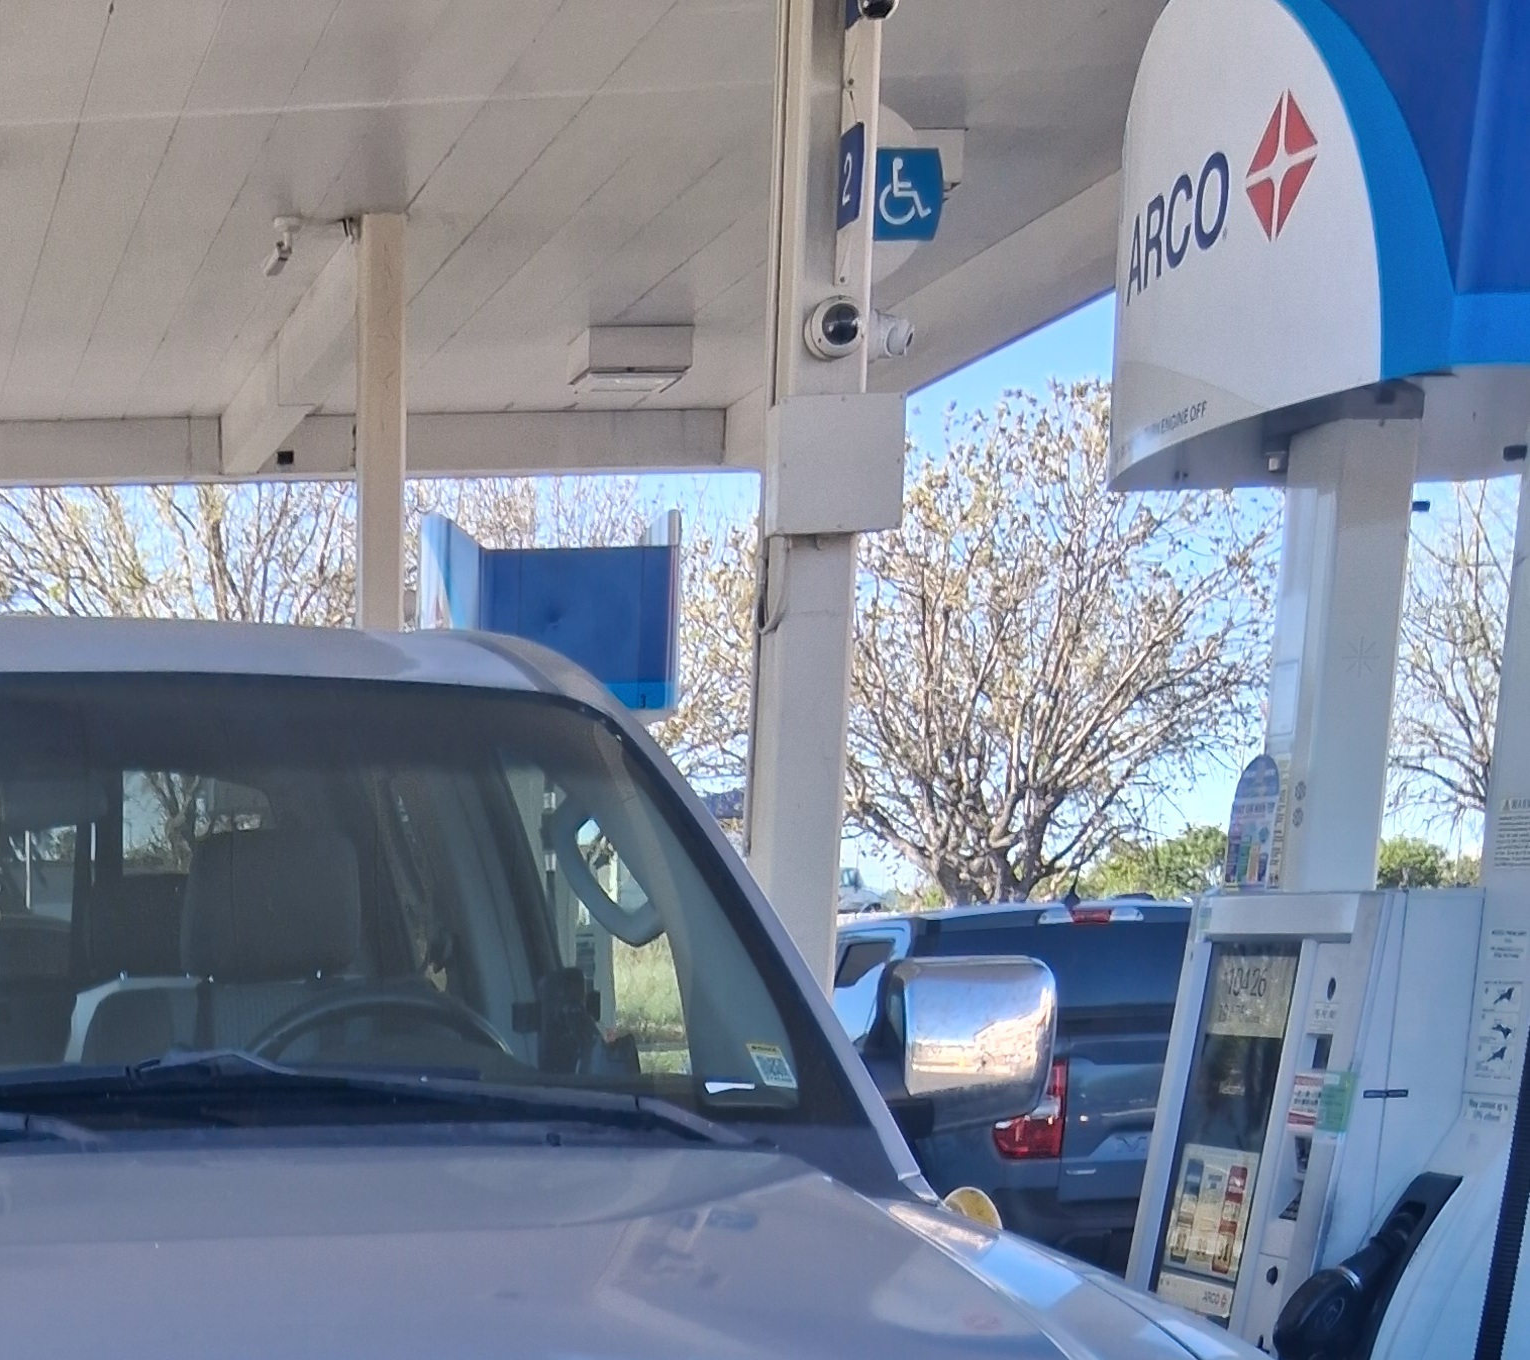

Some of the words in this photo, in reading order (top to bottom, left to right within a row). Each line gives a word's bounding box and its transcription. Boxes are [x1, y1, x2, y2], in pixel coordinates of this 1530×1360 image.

[842, 152, 852, 206] 2
[1126, 151, 1230, 307] ARCO
[1190, 400, 1207, 422] OFF
